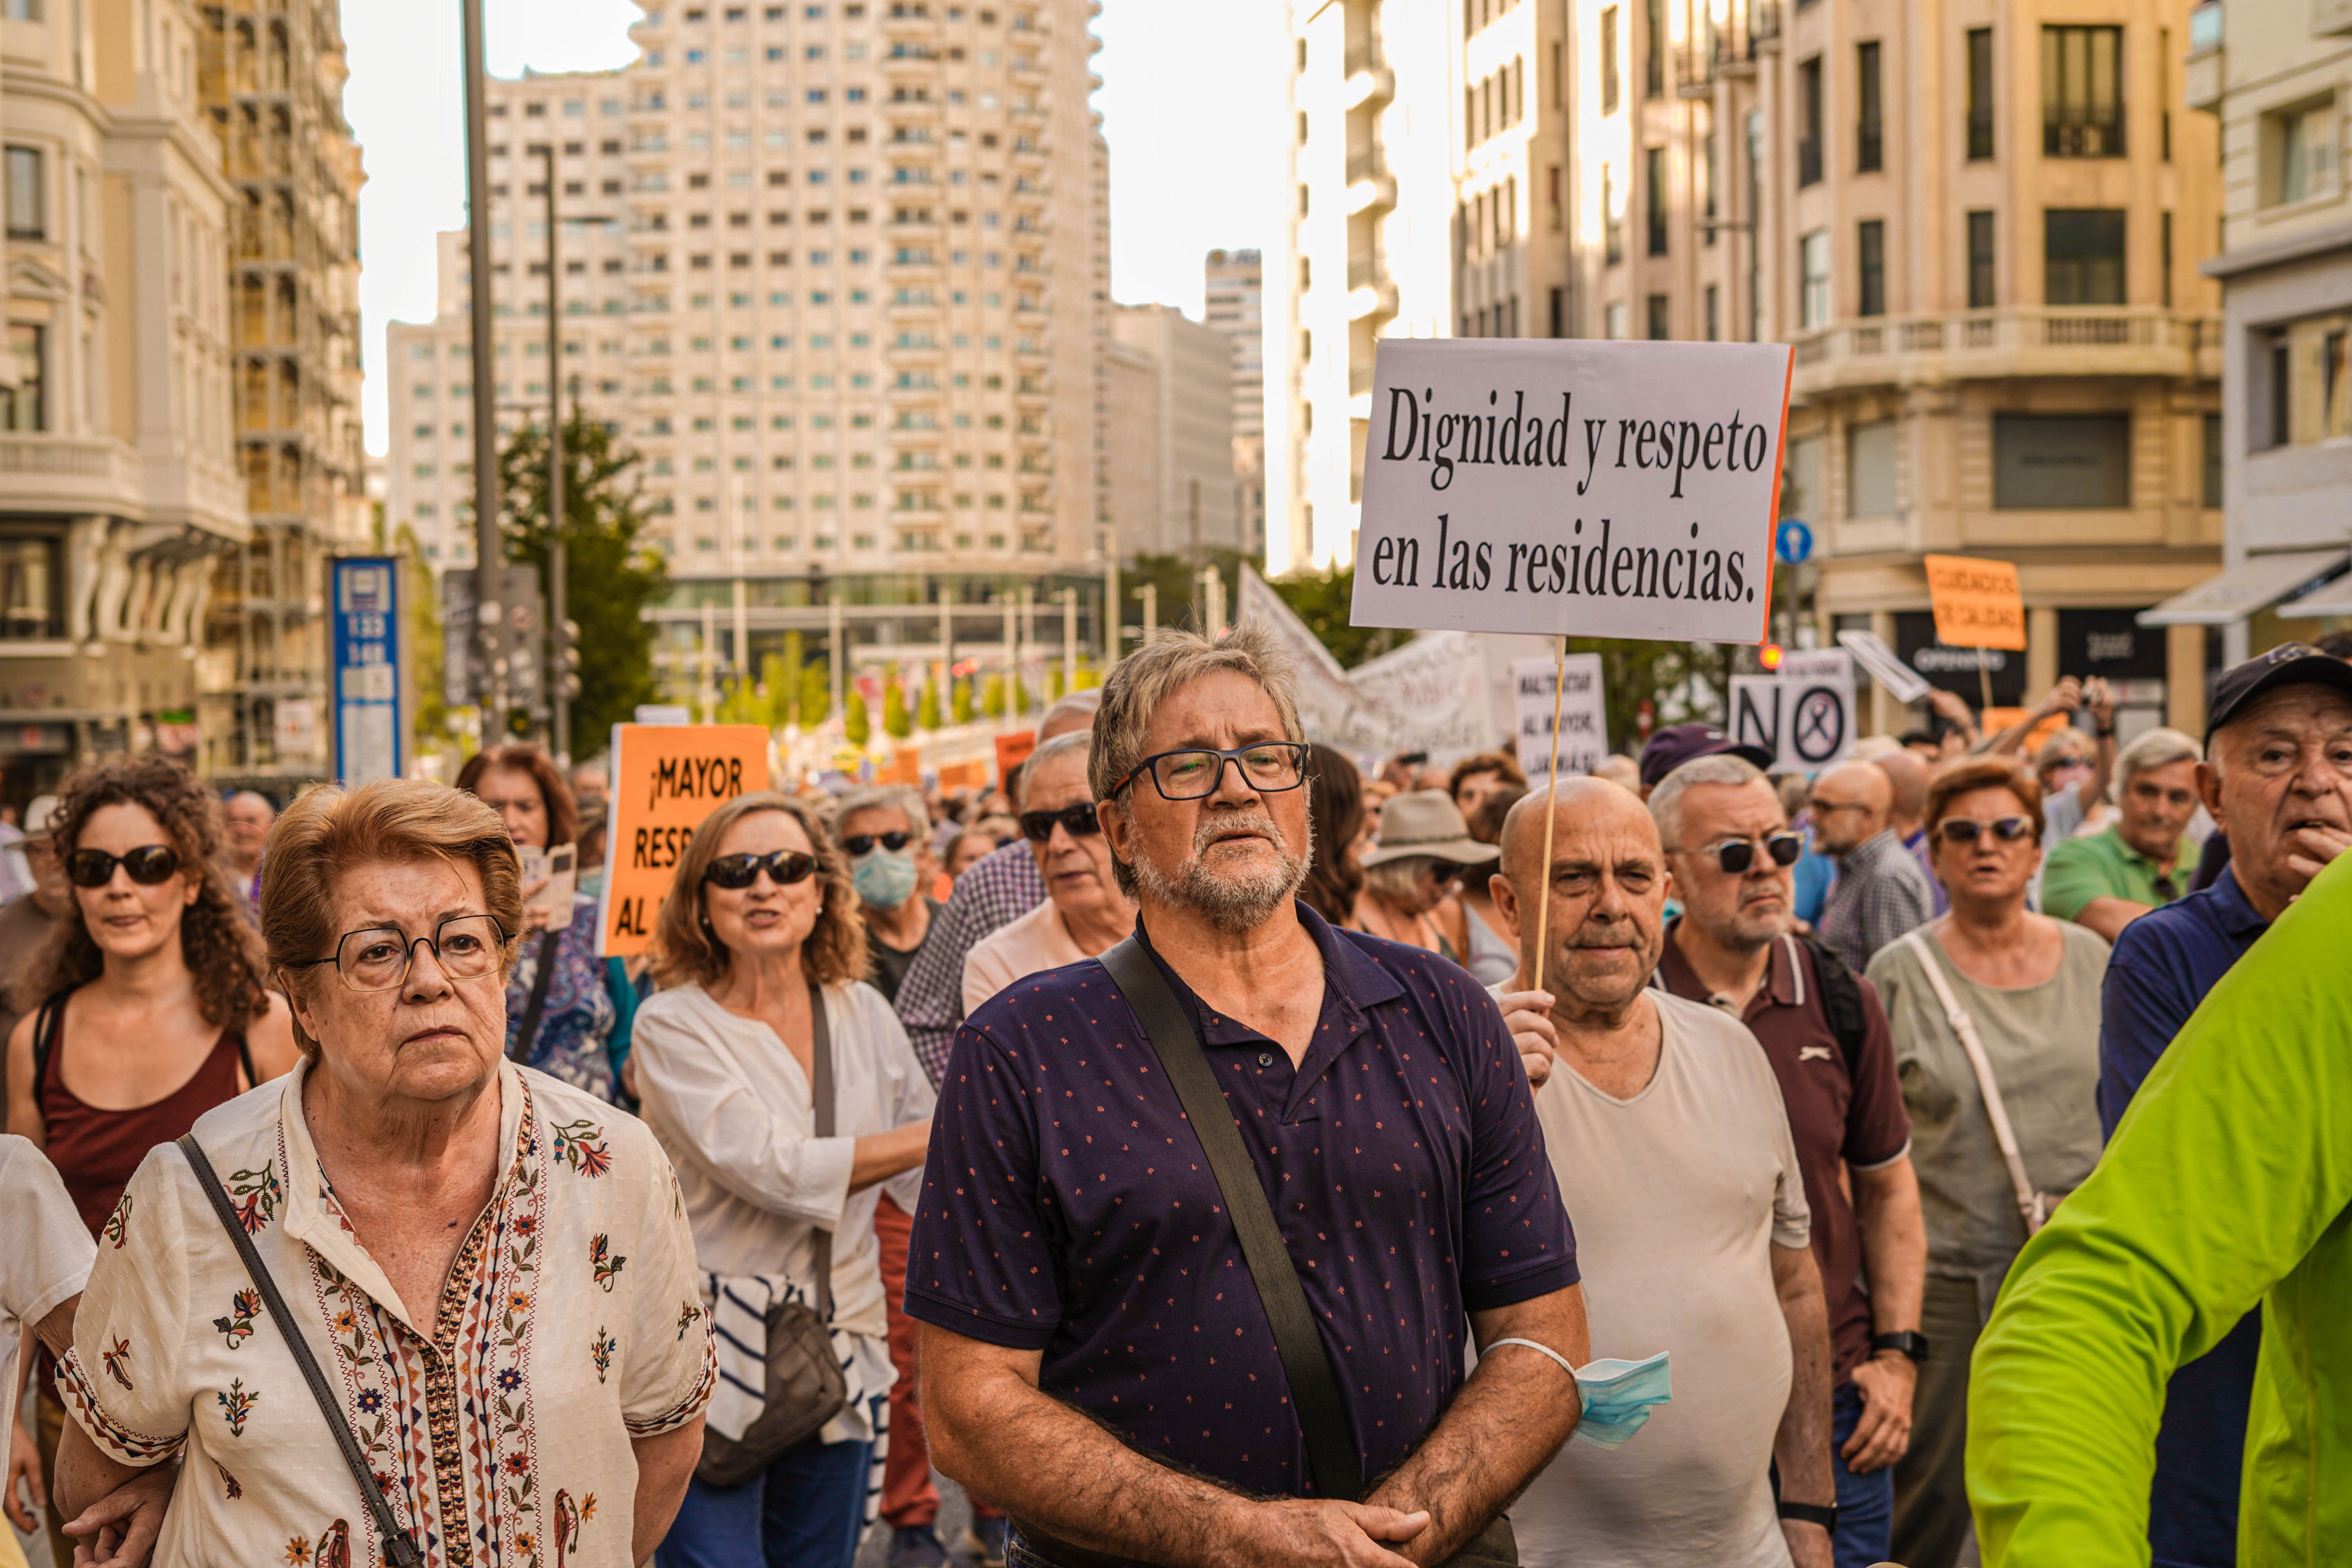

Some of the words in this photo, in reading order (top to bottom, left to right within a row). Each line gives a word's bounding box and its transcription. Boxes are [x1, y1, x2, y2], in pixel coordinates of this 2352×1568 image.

[1381, 387, 1571, 491] Dignidad
[1577, 419, 1607, 496] y
[1614, 409, 1767, 499] respeto
[1372, 536, 1419, 587] en
[1432, 513, 1492, 591] las
[1504, 518, 1754, 603] residencias.
[1738, 686, 1845, 763] NO
[649, 758, 742, 811] ¡MAYOR
[615, 897, 647, 936] AL
